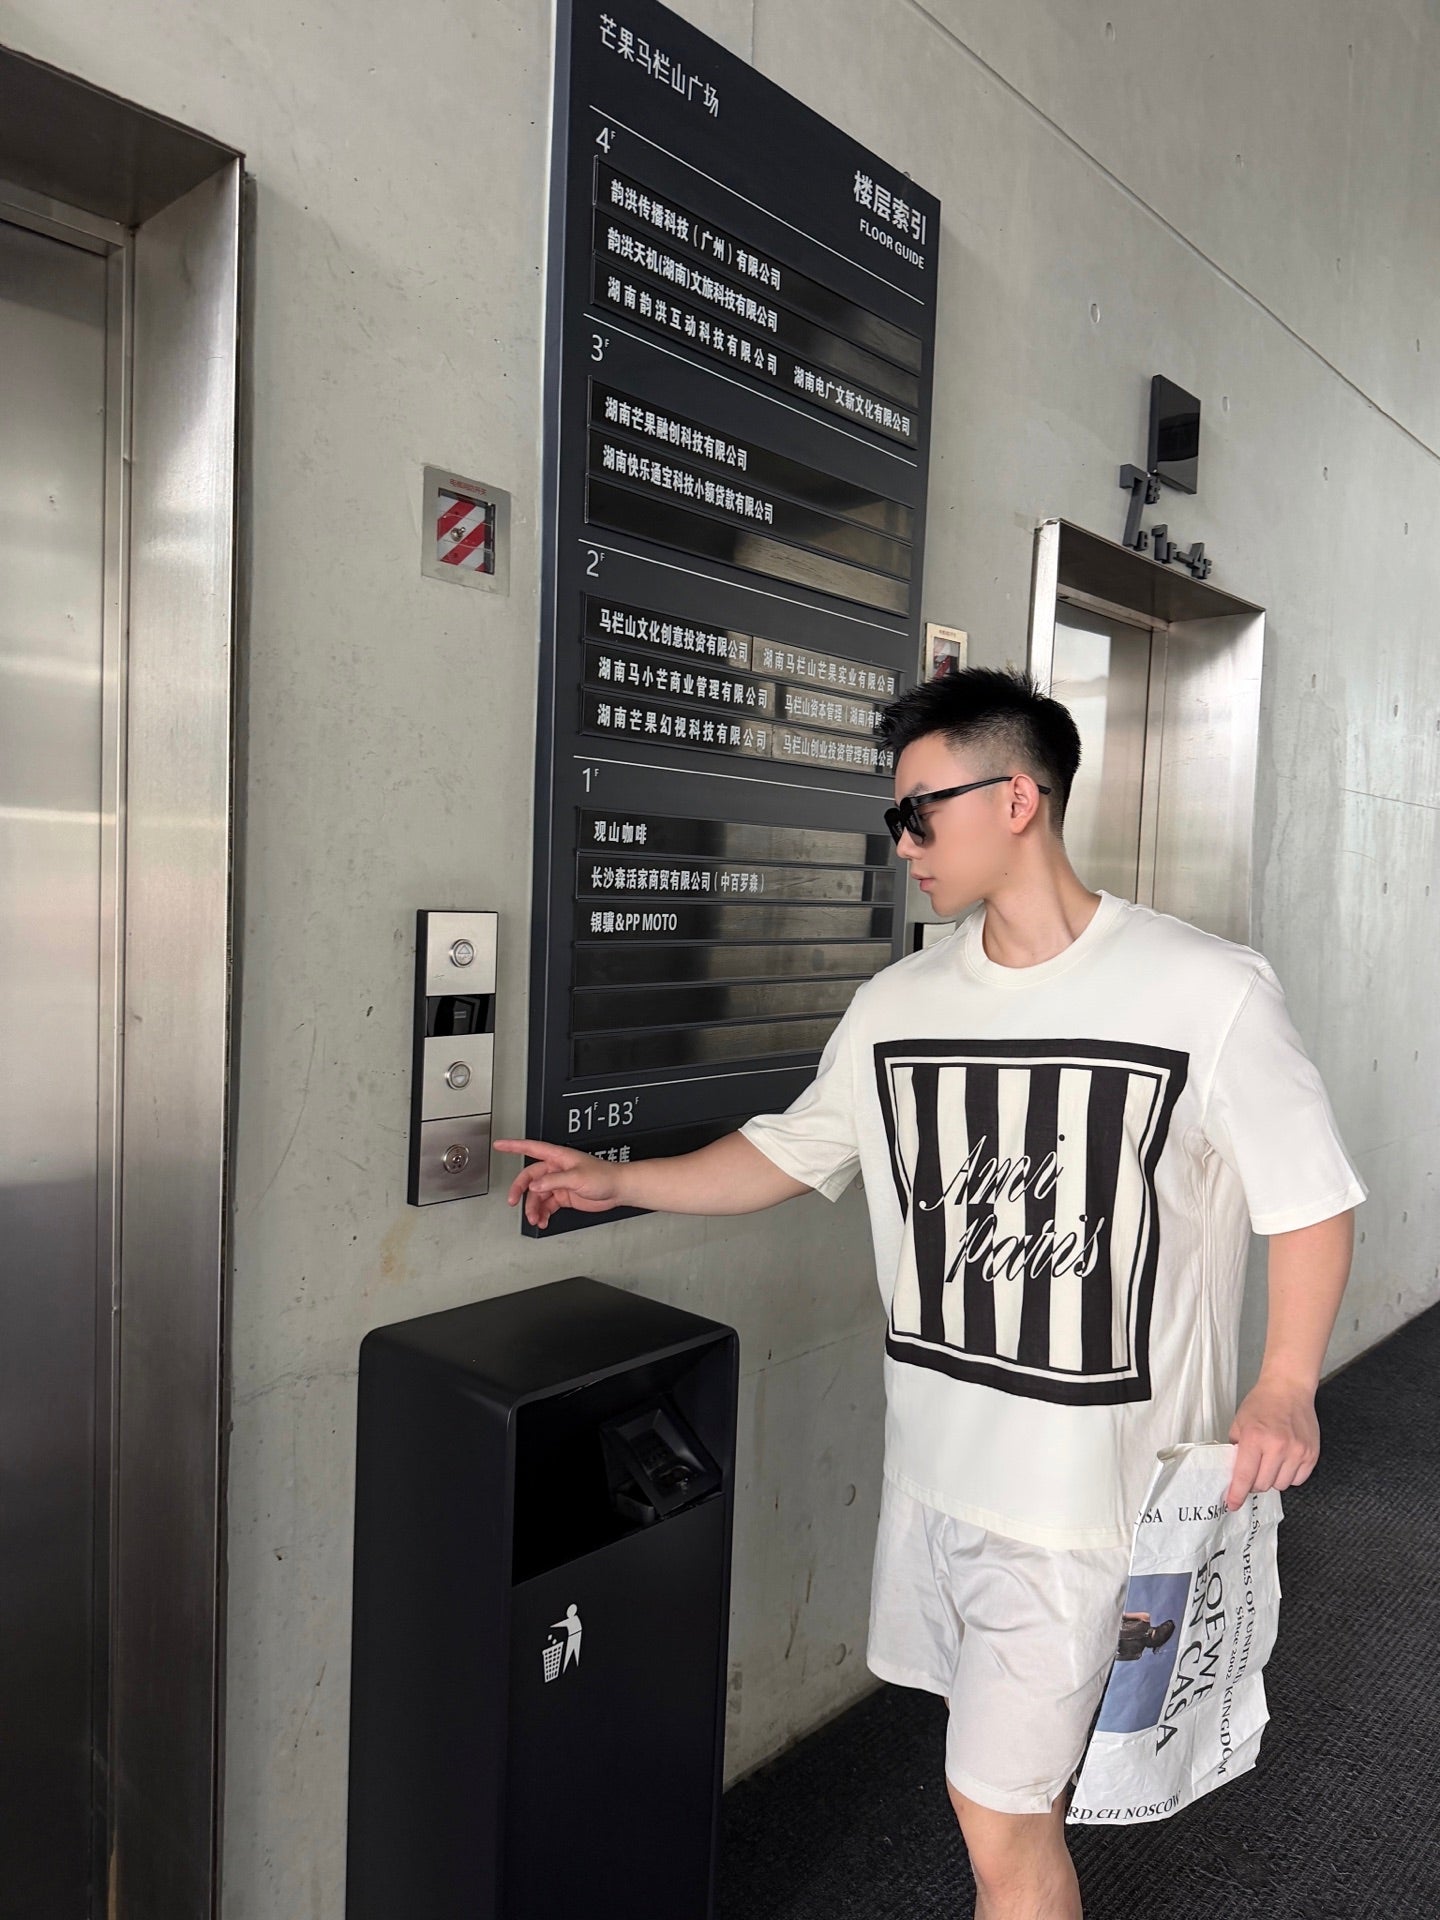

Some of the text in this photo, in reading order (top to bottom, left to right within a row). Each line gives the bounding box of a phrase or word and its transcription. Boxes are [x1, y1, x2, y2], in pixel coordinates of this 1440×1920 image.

[600, 13, 720, 118] 芒果马栏山广场
[853, 169, 927, 246] 楼层索引
[859, 218, 926, 270] FLOOR GUIDE
[607, 275, 777, 376] 湖南韵洪互动科技有限公司
[793, 365, 911, 437] 湖南电广文新文化有限公司
[604, 396, 748, 472] 湖南芒果融创科技有限公司
[602, 444, 774, 525] 湖南快乐通宝科技小额贷款有限公司
[599, 608, 749, 663] 马栏山文化创意投资有限公司
[598, 656, 768, 709] 湖南马小芒商业管理有限公司
[763, 647, 895, 696] 湖南马栏山芒果实业有限公司
[597, 703, 767, 751] 湖南芒果幻视科技有限公司
[783, 734, 894, 769] 马栏山创业投资管理有限公司
[593, 820, 648, 846] 观山咖啡
[642, 913, 678, 931] MOTO
[588, 1145, 631, 1163] 下车库
[1244, 1590, 1257, 1615] OF
[1225, 1605, 1243, 1680] Since 2002
[1156, 1640, 1202, 1757] CASA
[1217, 1684, 1234, 1776] KINGDOM
[1096, 1807, 1121, 1820] CH
